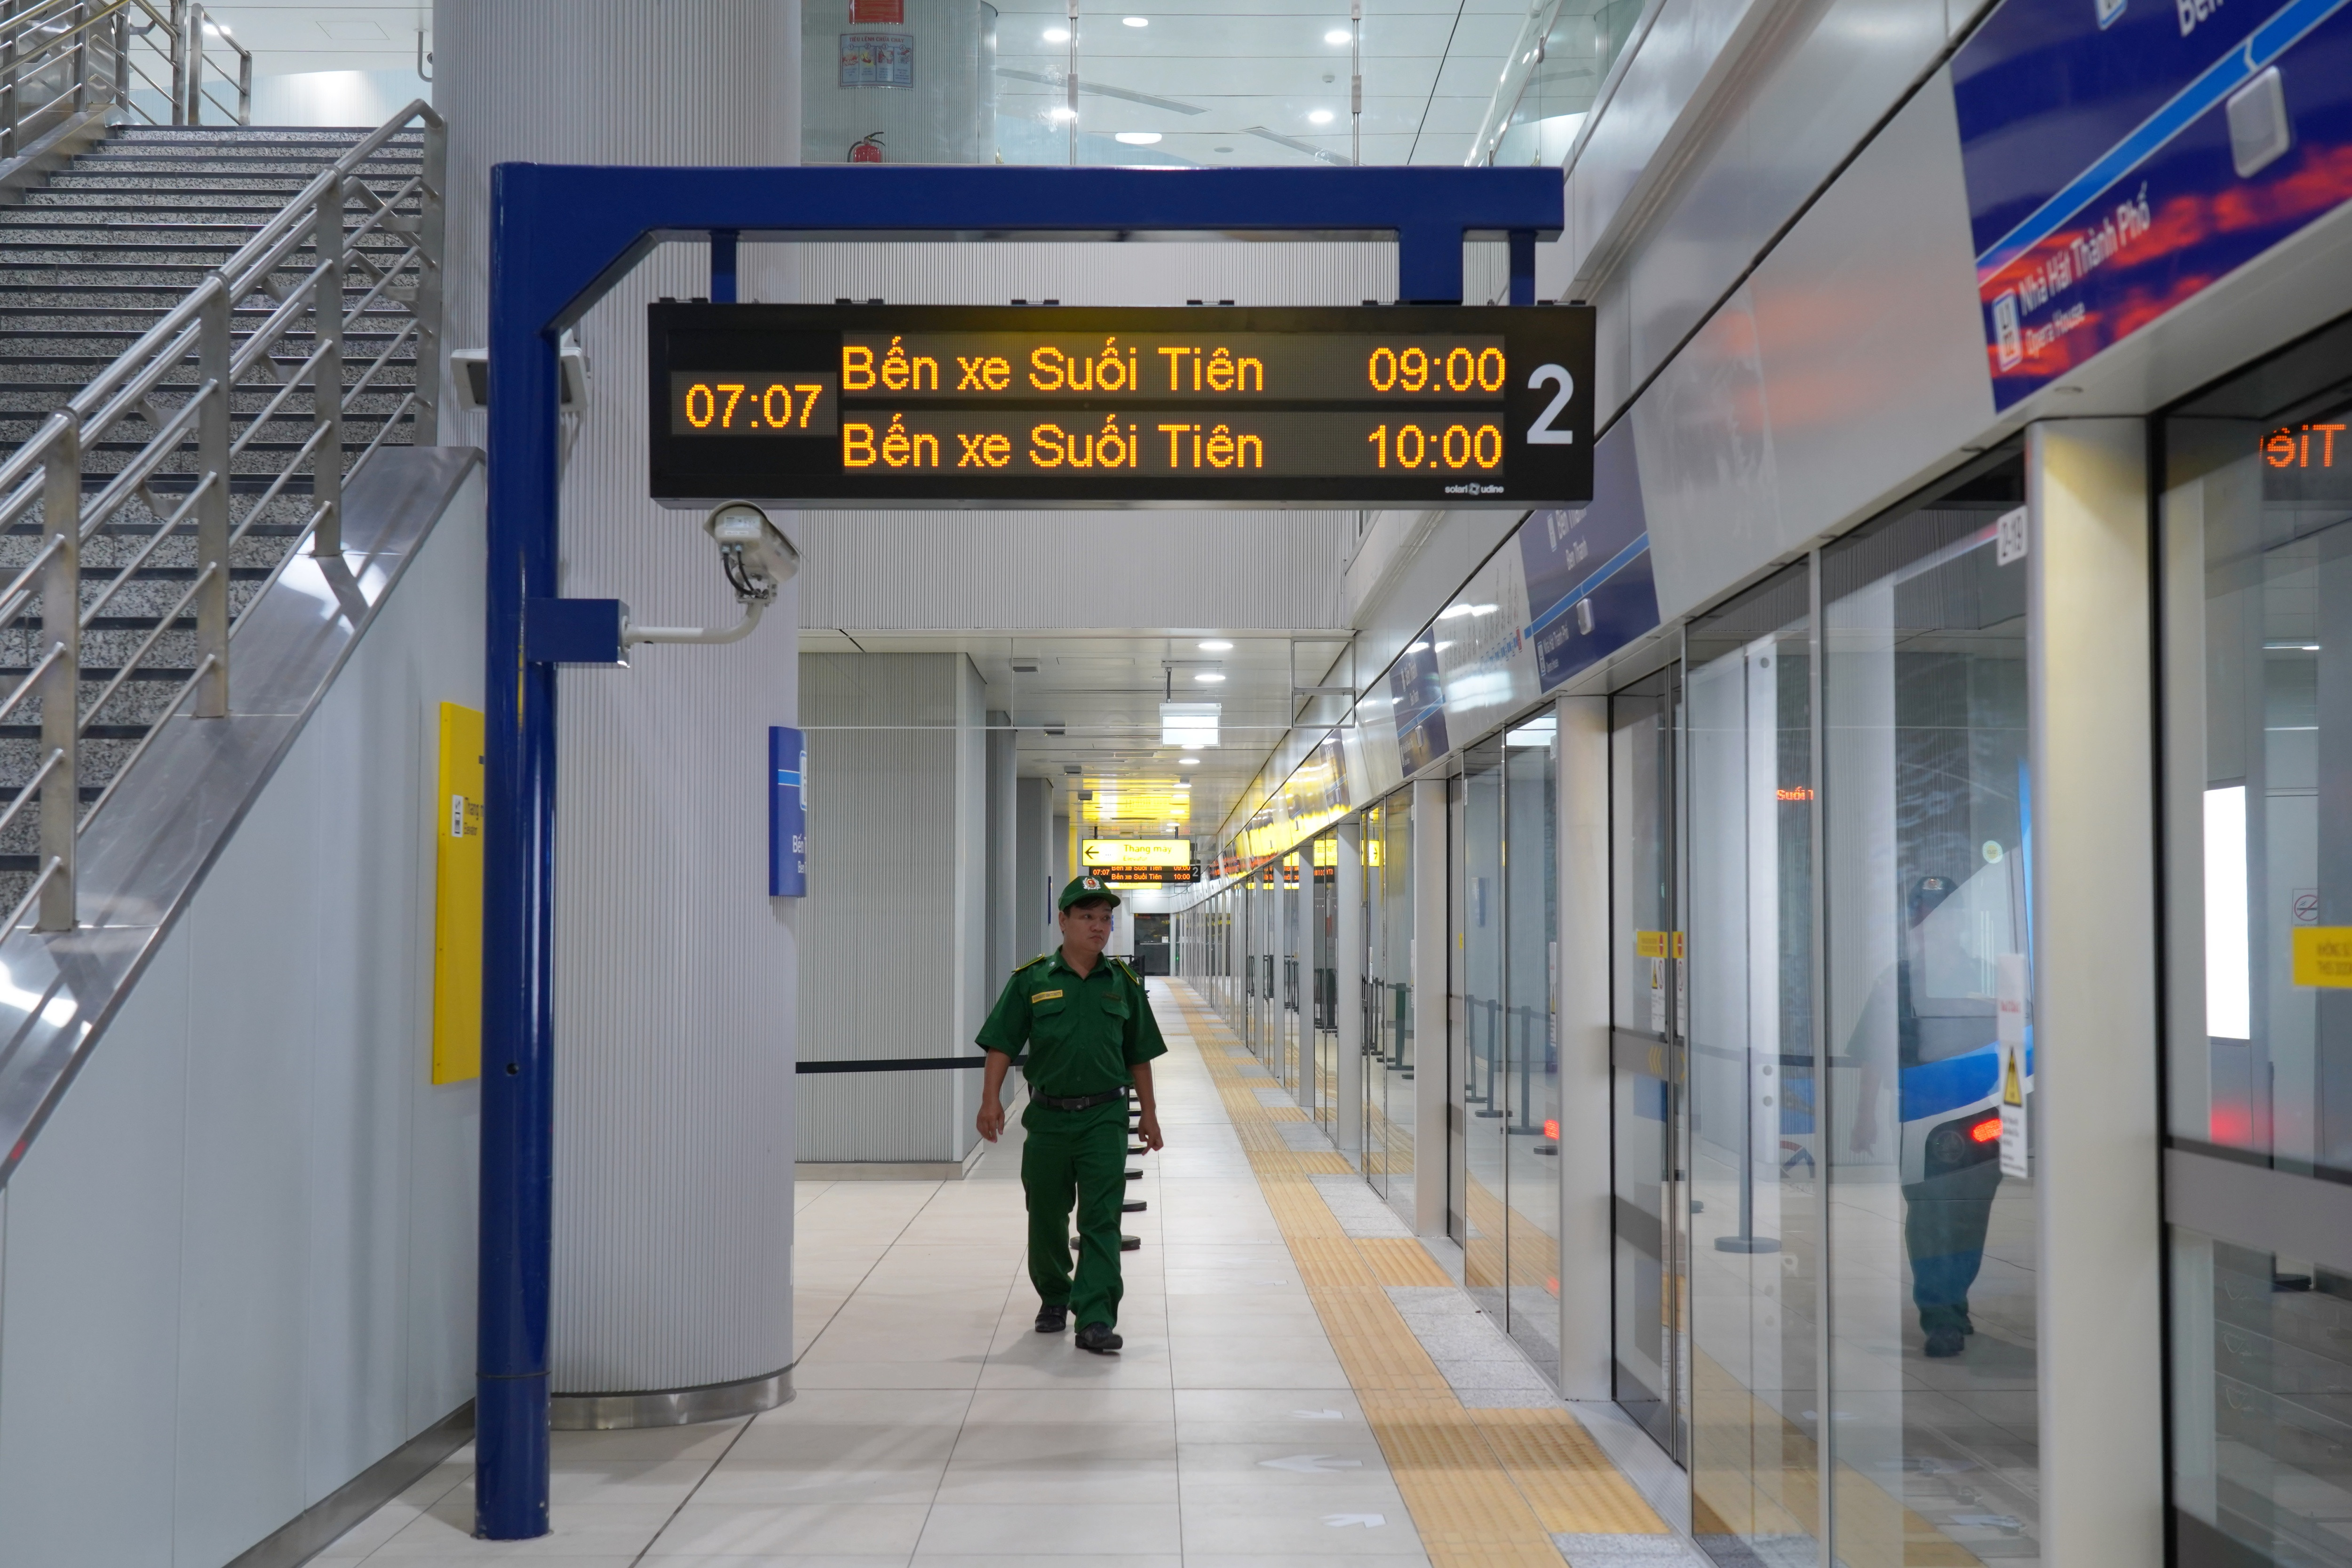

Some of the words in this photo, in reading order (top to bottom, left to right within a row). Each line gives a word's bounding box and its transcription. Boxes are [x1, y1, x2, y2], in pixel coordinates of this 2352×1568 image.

[843, 336, 938, 390] Bến
[957, 357, 1010, 390] xe
[1029, 336, 1136, 391] Suối
[1158, 347, 1263, 391] Tiên
[1369, 348, 1505, 391] 09:00
[686, 384, 822, 428] 07:07
[1527, 364, 1574, 445] 2
[843, 413, 938, 467] Bến
[957, 434, 1010, 467] xe
[1029, 414, 1136, 468] Suối
[1158, 424, 1263, 468] Tiên
[1368, 425, 1502, 469] 10:00
[1445, 485, 1468, 493] solari
[1480, 485, 1504, 493] udine
[1123, 844, 1151, 854] Thang
[1192, 867, 1199, 877] 2
